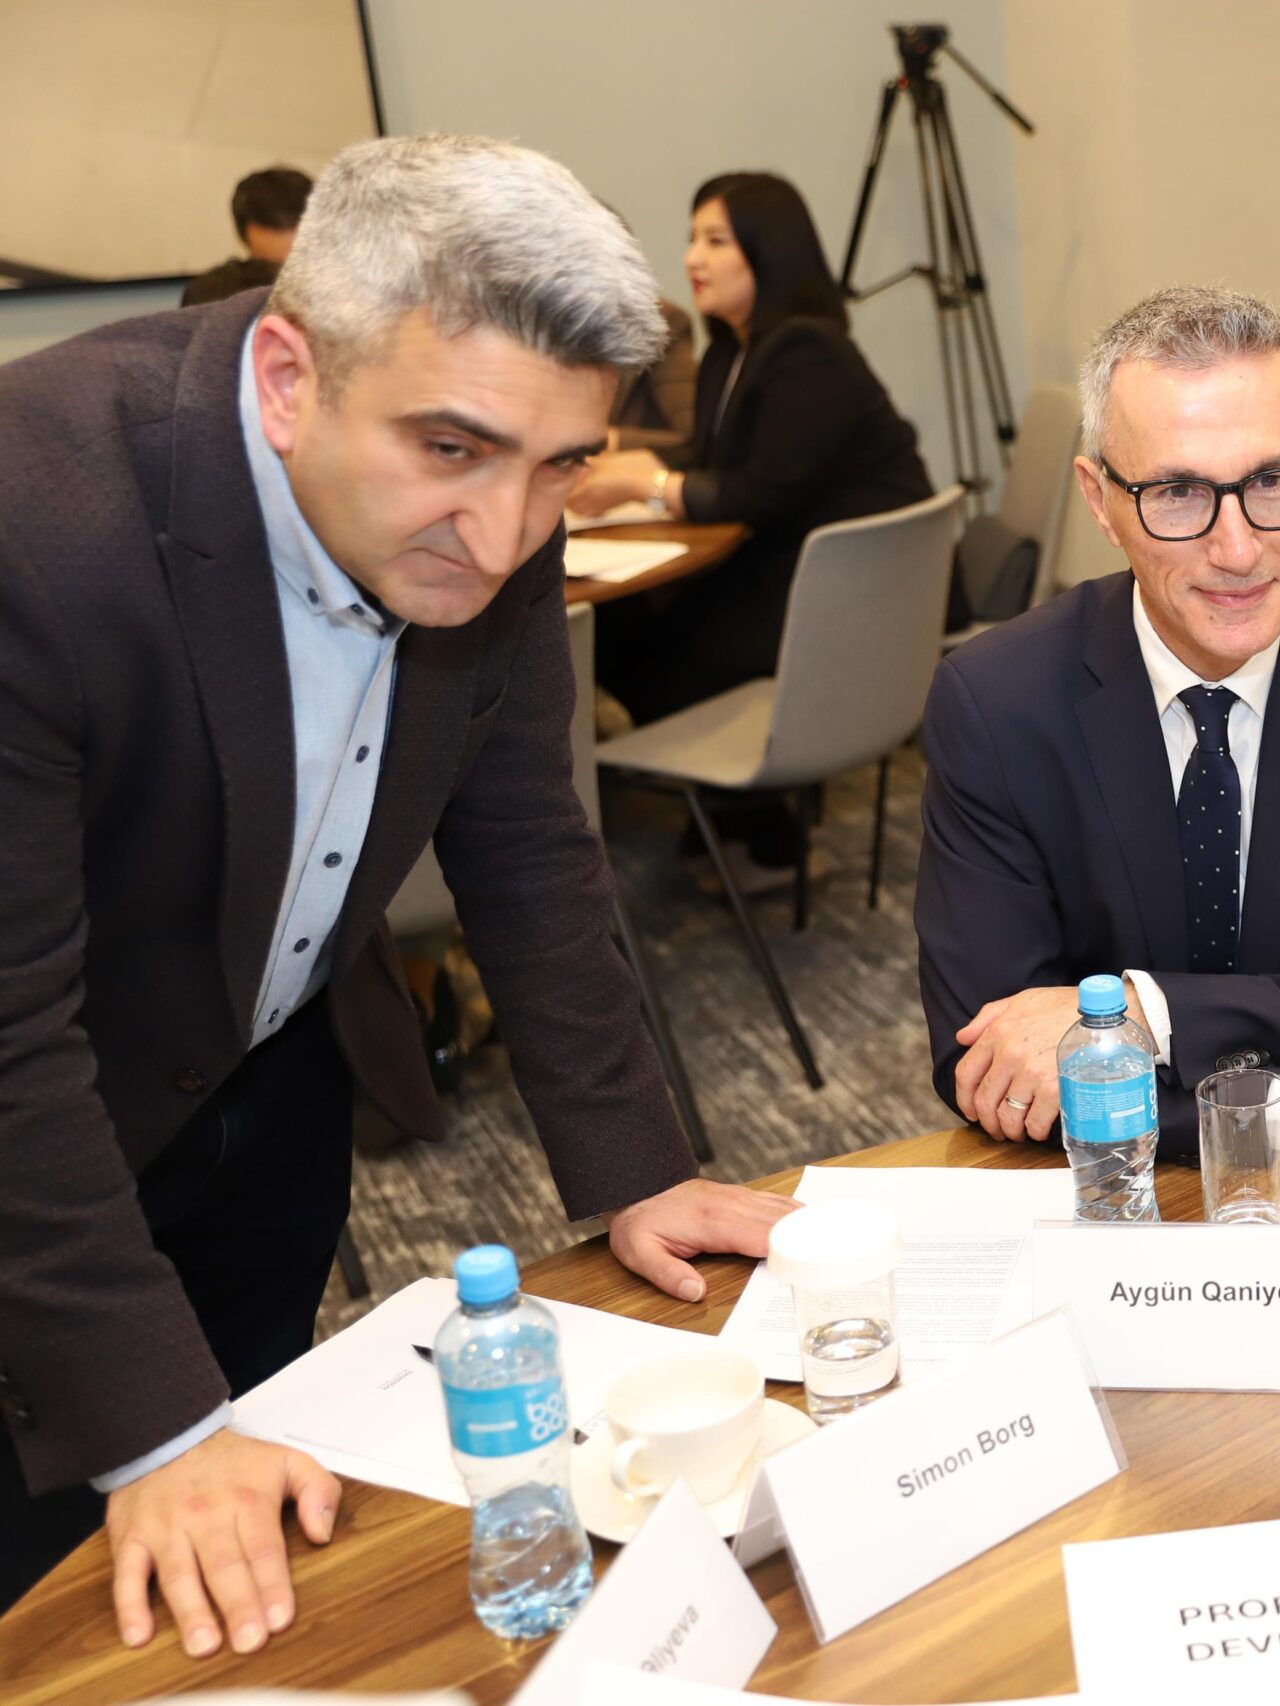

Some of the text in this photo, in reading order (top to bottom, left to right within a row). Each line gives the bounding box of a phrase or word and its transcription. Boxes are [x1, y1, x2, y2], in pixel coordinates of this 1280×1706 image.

[1110, 1281, 1193, 1307] Aygün
[897, 1413, 1036, 1498] Simon Borg
